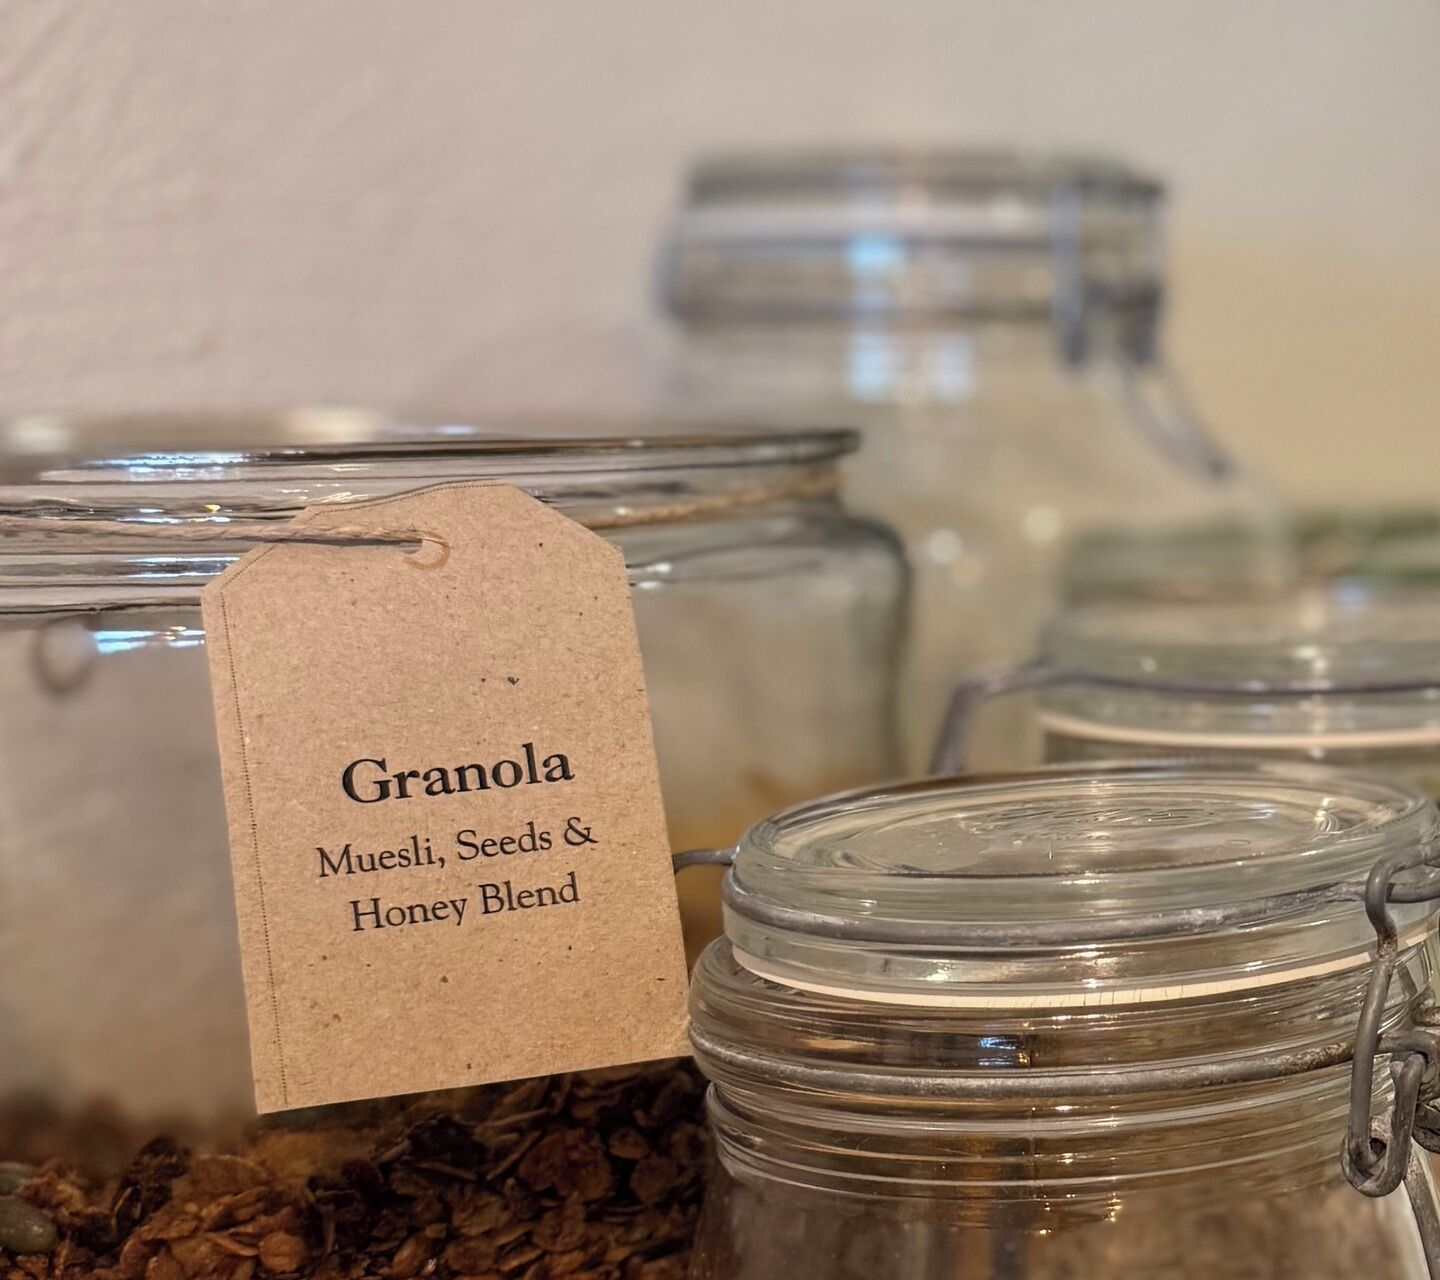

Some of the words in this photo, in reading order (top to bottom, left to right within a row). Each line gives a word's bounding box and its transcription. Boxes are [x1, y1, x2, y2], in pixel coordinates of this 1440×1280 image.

[341, 742, 576, 804] Granola
[315, 834, 446, 878] Muesli,
[456, 821, 553, 861] Seeds
[563, 816, 599, 848] &
[349, 897, 468, 932] Honey
[478, 871, 580, 915] Blend
